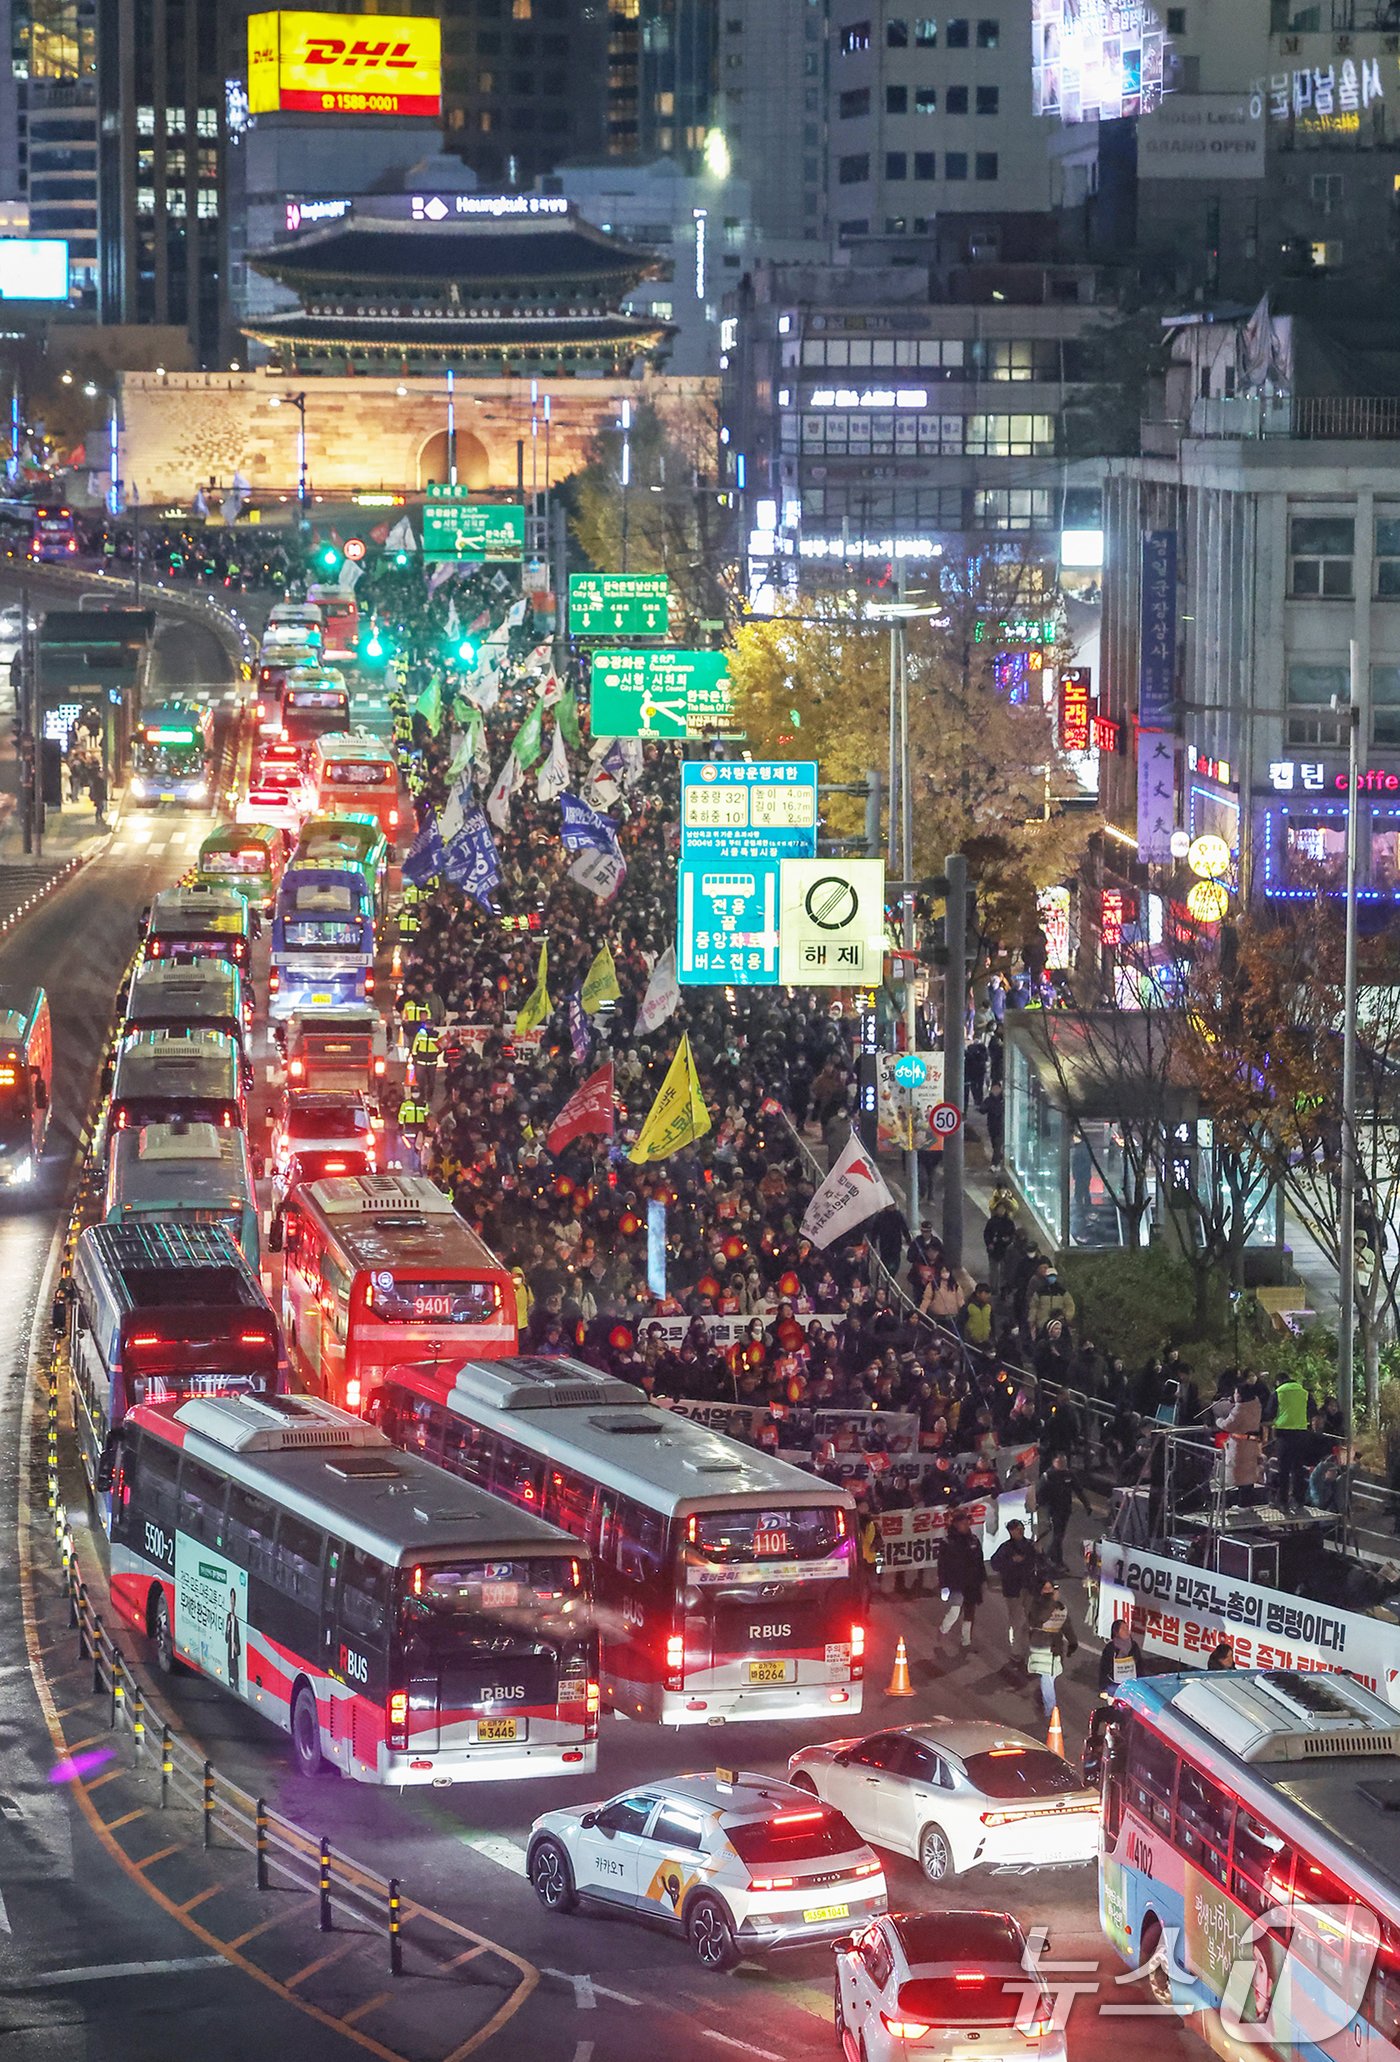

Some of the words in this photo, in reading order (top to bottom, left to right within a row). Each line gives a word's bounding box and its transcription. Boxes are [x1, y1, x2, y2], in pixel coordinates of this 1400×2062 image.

[254, 49, 273, 64] DHL
[304, 39, 417, 68] DHL
[337, 95, 398, 110] 1588-0001
[1210, 140, 1257, 152] OPEN
[456, 196, 528, 215] Heungkuk
[610, 655, 646, 670] 광화문
[719, 766, 798, 780] 차량운행제한
[1268, 762, 1325, 790] 캡틴
[689, 790, 721, 804] 총중량
[756, 788, 777, 799] 높이
[787, 788, 811, 798] 4.0m
[782, 802, 811, 811] 16.7m
[689, 810, 720, 824] 축하중
[788, 813, 811, 823] 2.5m
[712, 898, 746, 915] 전용
[695, 953, 762, 971] 버스전용
[936, 1111, 956, 1131] 50
[1174, 1123, 1189, 1142] 4
[416, 1298, 449, 1314] 9401
[144, 1521, 174, 1566] 5500-2
[755, 1533, 787, 1552] 1101
[483, 1585, 516, 1605] 5500-2
[1113, 1559, 1173, 1600] 120만
[1175, 1571, 1263, 1628] 민주노총의
[1266, 1604, 1347, 1652] 명령이다!
[758, 1669, 784, 1681] 8264
[487, 1727, 515, 1739] 3445
[1126, 1831, 1153, 1881] M4102
